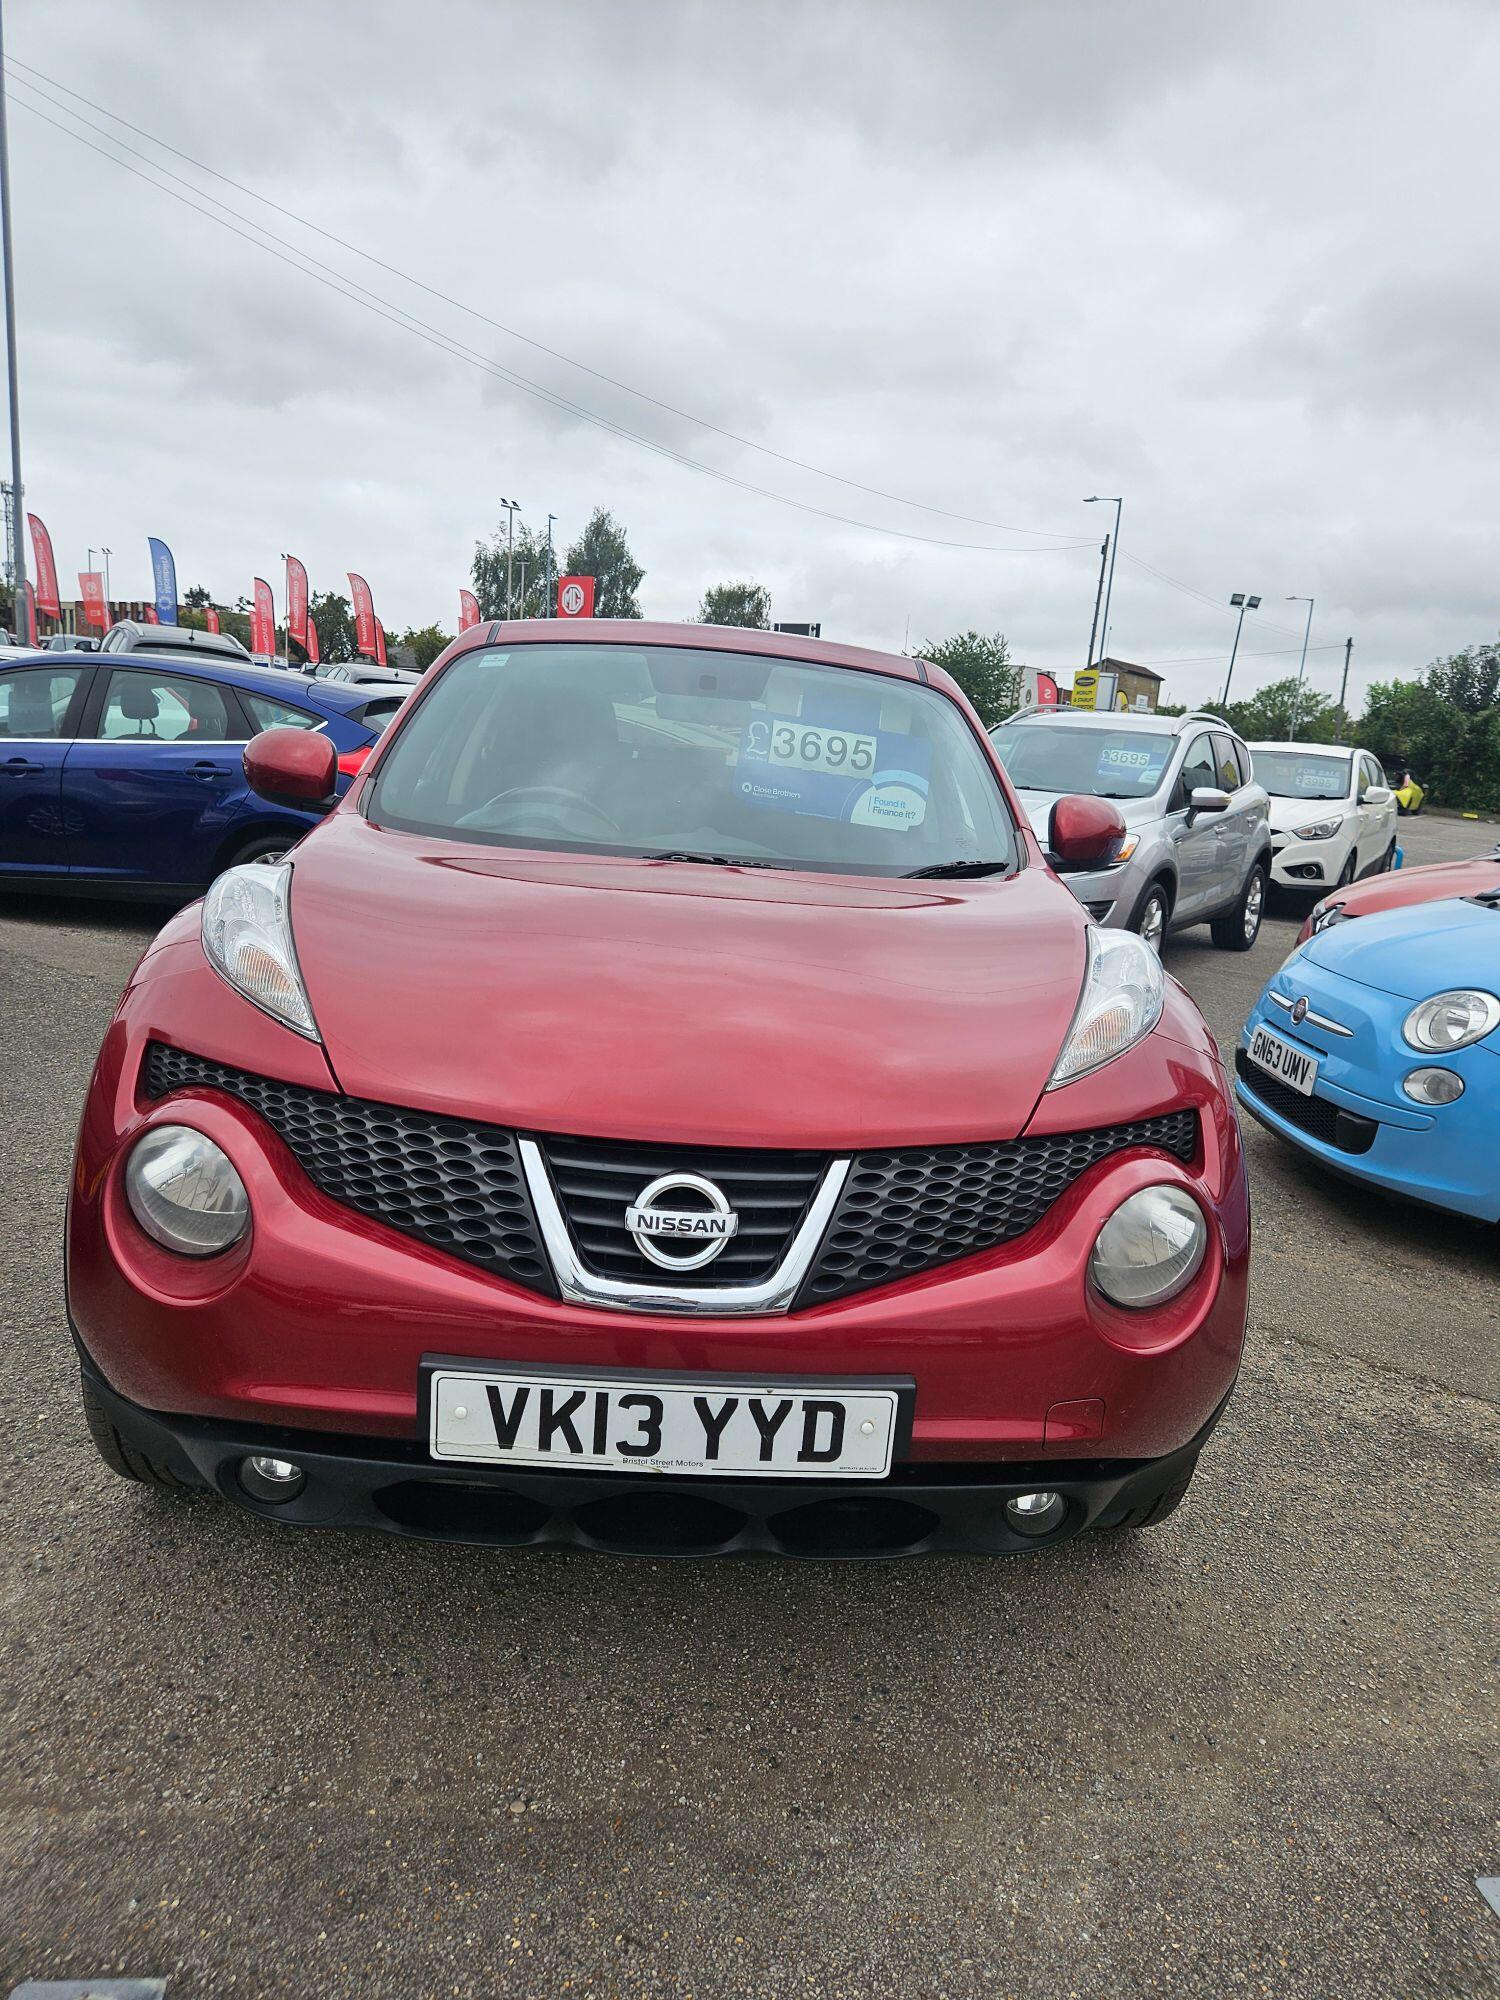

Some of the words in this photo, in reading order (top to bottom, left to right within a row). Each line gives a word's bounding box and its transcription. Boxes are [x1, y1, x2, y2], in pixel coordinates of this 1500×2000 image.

[562, 586, 583, 612] MG
[753, 785, 772, 794] Close
[772, 788, 801, 799] Brothers
[873, 796, 899, 808] Found
[900, 800, 906, 809] it
[872, 805, 904, 818] Finance
[904, 810, 916, 820] it?
[1253, 1032, 1283, 1069] GN63
[1282, 1049, 1311, 1086] UMV
[637, 1214, 726, 1233] NISSAN
[485, 1385, 664, 1457] VK13
[693, 1396, 846, 1462] YYD
[622, 1457, 648, 1466] Bristol
[650, 1458, 673, 1467] Street
[676, 1459, 704, 1468] Motors
